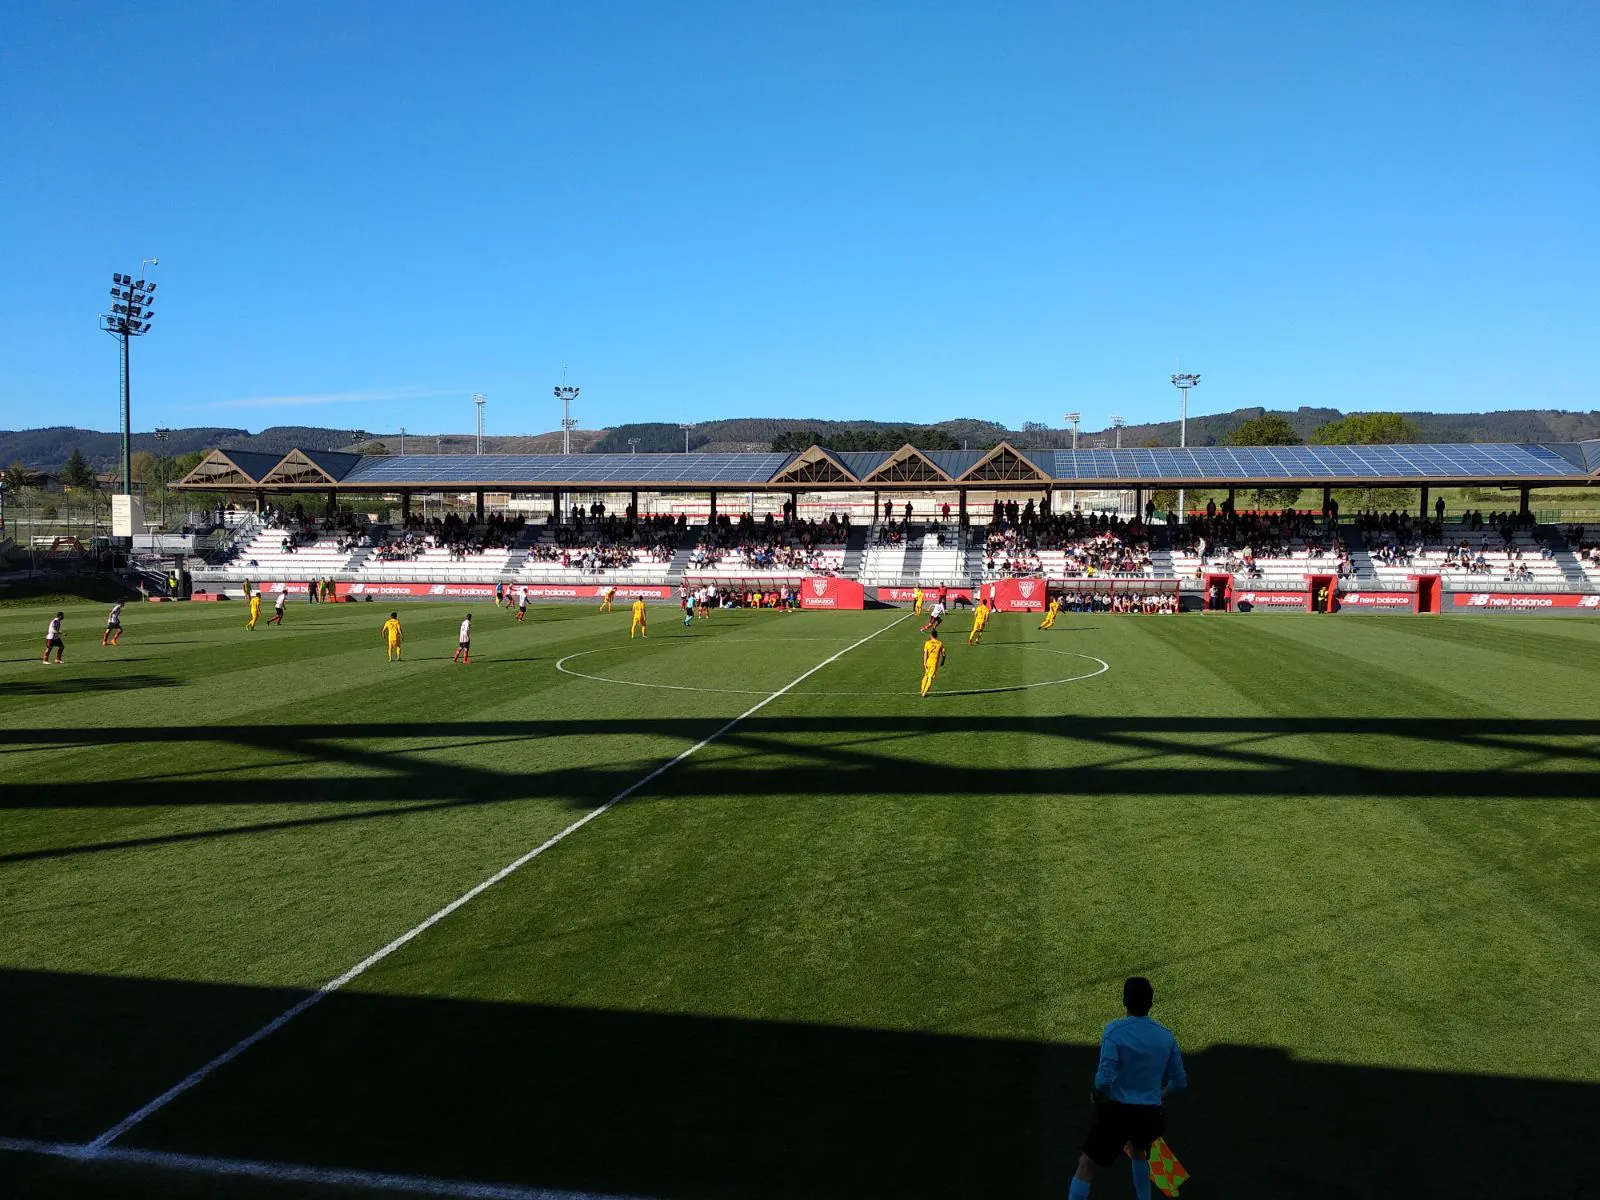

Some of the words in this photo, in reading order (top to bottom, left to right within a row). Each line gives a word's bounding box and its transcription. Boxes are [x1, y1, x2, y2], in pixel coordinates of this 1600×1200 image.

[461, 587, 492, 595] balance
[544, 588, 576, 596] balance
[629, 588, 661, 596] balance
[1511, 597, 1553, 606] balance
